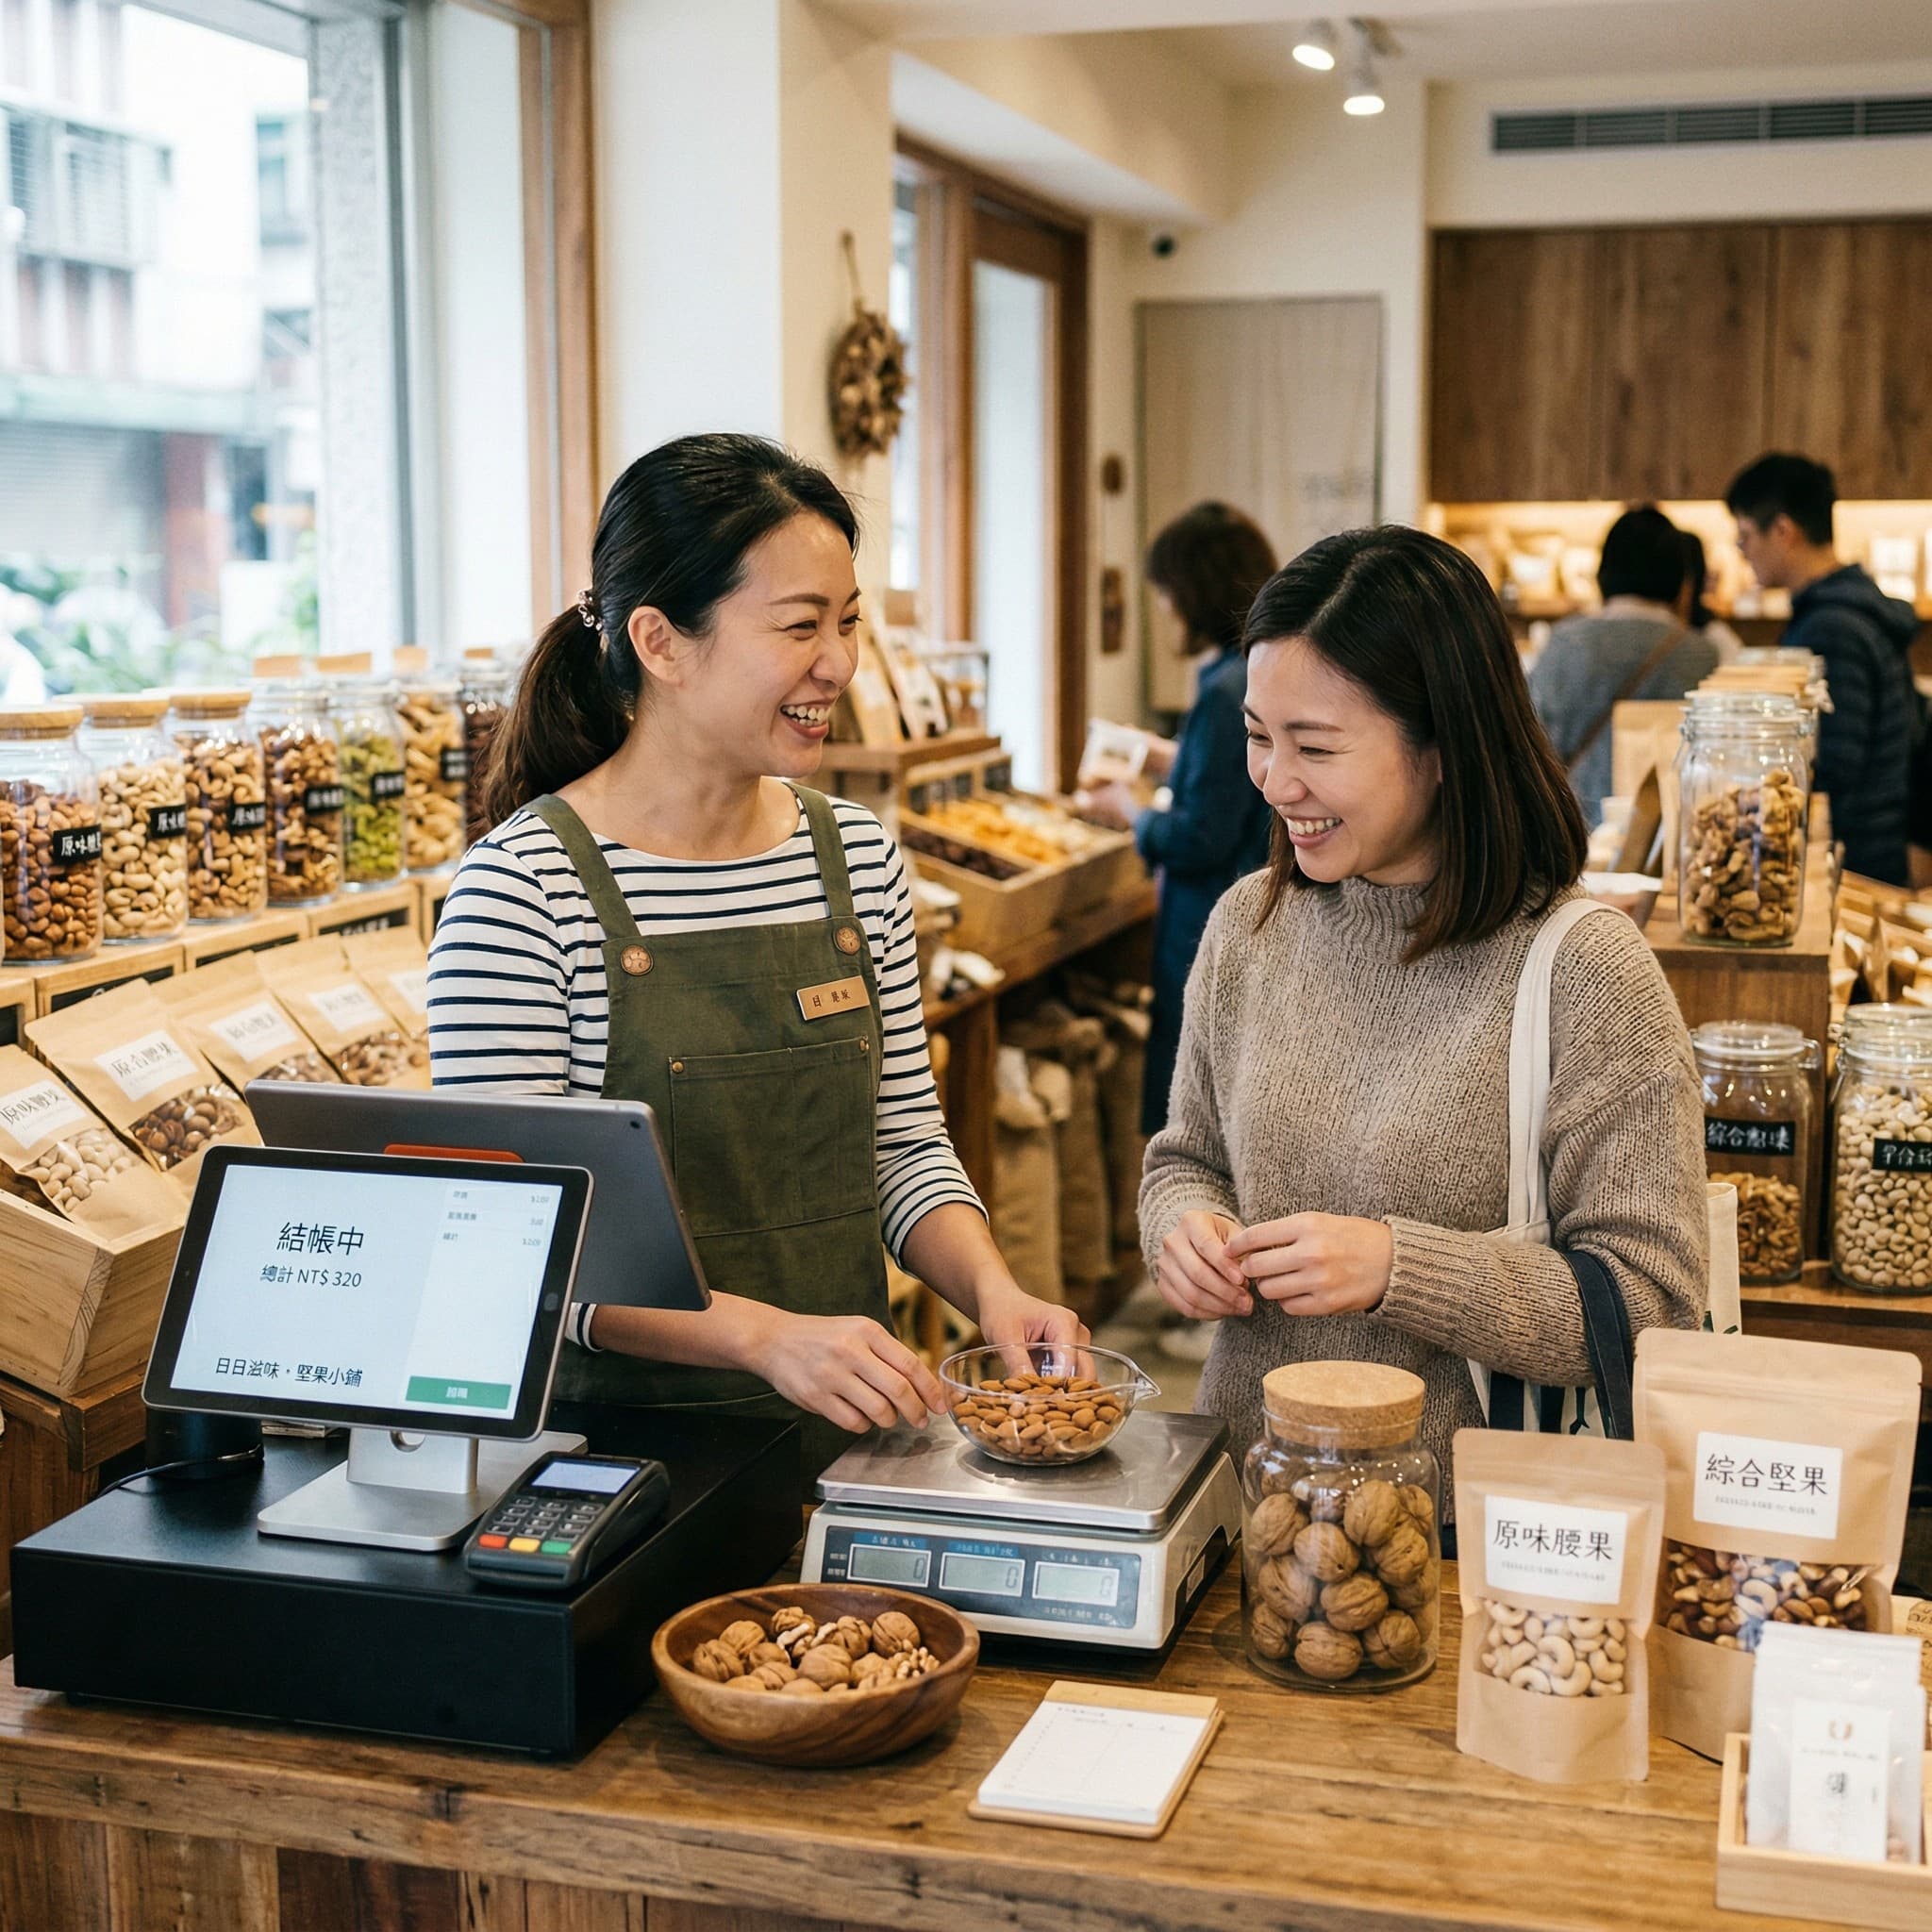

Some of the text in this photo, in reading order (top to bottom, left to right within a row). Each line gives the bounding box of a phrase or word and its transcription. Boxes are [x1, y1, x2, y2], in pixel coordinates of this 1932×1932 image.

[276, 1222, 364, 1256] 結帳中
[332, 1271, 362, 1288] 320
[1705, 1453, 1828, 1496] 綜合堅果
[1493, 1519, 1613, 1562] 原味腰果
